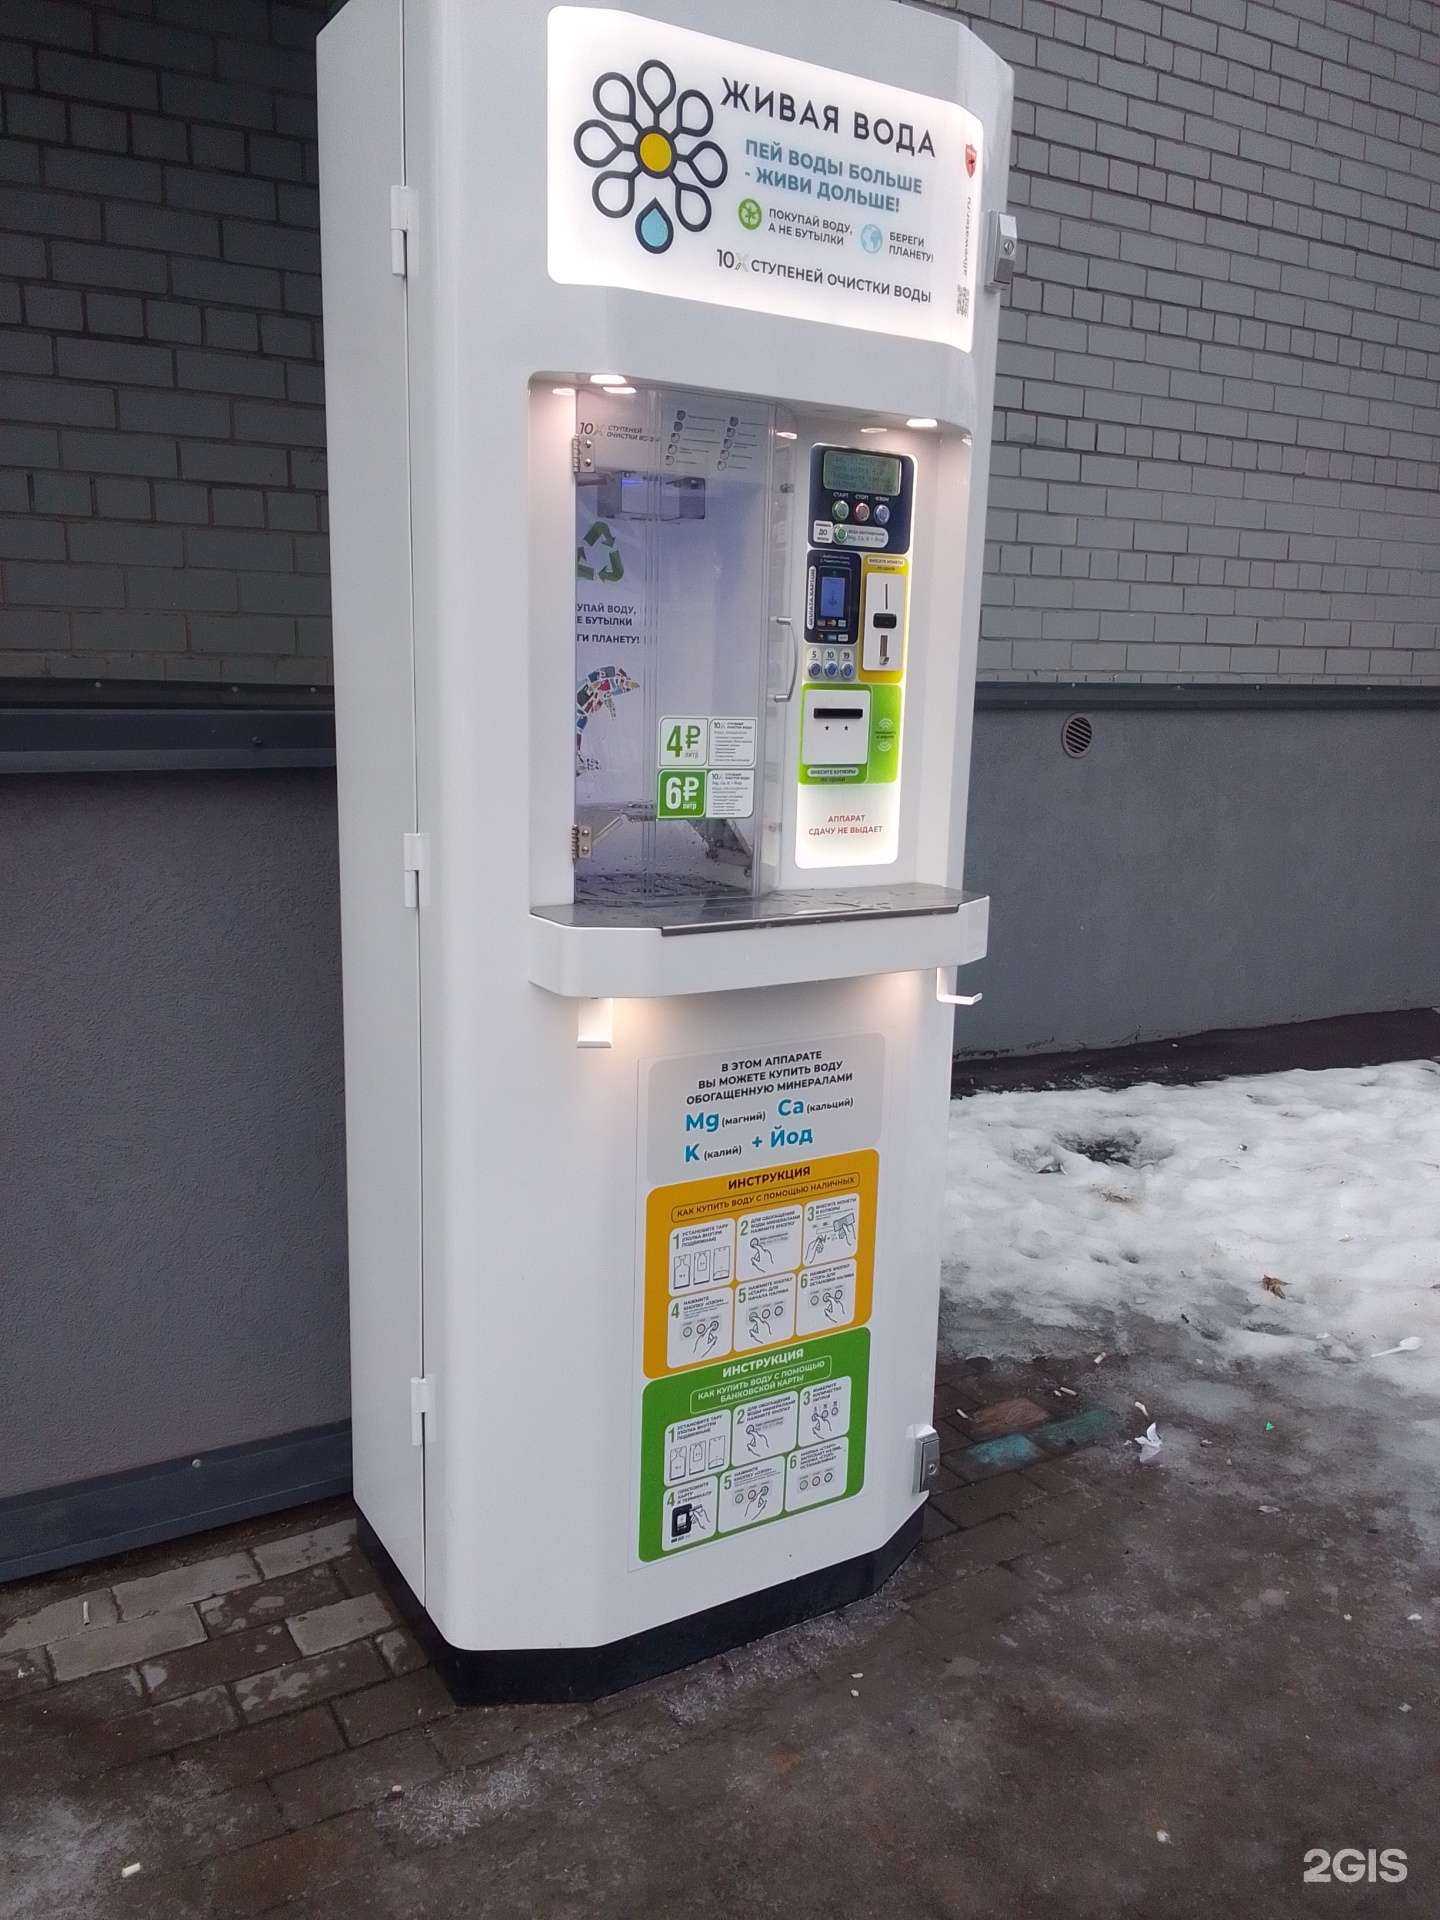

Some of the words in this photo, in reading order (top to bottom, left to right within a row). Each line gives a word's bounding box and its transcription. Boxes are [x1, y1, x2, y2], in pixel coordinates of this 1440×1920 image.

[720, 76, 839, 134] ЖИВАЯ
[853, 111, 935, 158] ВОДА
[745, 139, 782, 162] ПЕЙ
[788, 149, 843, 177] ВОДЫ
[849, 163, 922, 194] БОЛЬШЕ
[756, 167, 812, 194] ЖИВИ
[817, 181, 900, 213] ДОЛЬШЕ!
[769, 208, 820, 228] ПОКУПАЙ
[822, 219, 853, 235] ВОДУ,
[768, 223, 776, 233] А
[779, 225, 793, 236] НЕ
[795, 227, 844, 246] БУТЫЛКИ
[889, 232, 925, 247] БЕРЕГИ
[889, 245, 934, 263] ПЛАНЕТУ!
[751, 259, 823, 284] СТУПЕНЕЙ
[827, 273, 890, 295] ОЧИСТКИ
[894, 286, 931, 303] ВОДЫ
[607, 604, 637, 615] ВОДУ,
[585, 616, 632, 626] БУТЫЛКИ
[592, 634, 640, 644] ПЛАНЕТУ!
[827, 651, 834, 659] 10
[828, 814, 865, 823] АППАРАТ
[808, 826, 835, 836] СДАЧУ
[837, 826, 848, 834] НЕ
[850, 825, 882, 834] ВЫДАЕТ
[721, 1063, 729, 1072] В
[732, 1059, 762, 1071] ЭТОМ
[765, 1050, 822, 1066] АППАРАТЕ
[698, 1079, 716, 1089] ВЫ
[719, 1072, 766, 1087] МОЖЕТЕ
[769, 1066, 811, 1079] КУПИТЬ
[814, 1061, 843, 1073] ВОДУ
[686, 1084, 774, 1105] ОБОГАЩЕННУЮ
[777, 1072, 853, 1091] МИНЕРАЛАМИ
[685, 1112, 719, 1132] Mg
[722, 1111, 766, 1128] (магний)
[778, 1098, 804, 1116] Ca
[806, 1097, 854, 1114] (кальций)
[703, 1145, 742, 1161] (калий)
[752, 1136, 763, 1148] +
[770, 1125, 813, 1148] Йод
[728, 1166, 810, 1191] ИНСТРУКЦИЯ
[677, 1207, 695, 1217] КАК
[696, 1202, 730, 1213] КУПИТЬ
[732, 1195, 754, 1208] ВОДУ
[763, 1185, 809, 1200] ПОМОЩЬЮ
[810, 1176, 855, 1191] НАЛИЧНЫХ
[807, 1206, 815, 1222] 3
[740, 1220, 749, 1236] 2
[673, 1233, 680, 1249] 1
[800, 1274, 808, 1288] 6
[738, 1287, 746, 1303] 5
[671, 1302, 680, 1318] 4
[722, 1348, 804, 1378] ИНСТРУКЦИЯ
[698, 1389, 715, 1400] КАК
[717, 1381, 749, 1395] КУПИТЬ
[750, 1375, 772, 1387] ВОДУ
[781, 1360, 825, 1377] ПОМОЩЬЮ
[720, 1381, 776, 1402] БАНКОВСКОЙ
[777, 1375, 804, 1388] КАРТЫ
[803, 1391, 811, 1406] 3
[736, 1409, 745, 1425] 2
[668, 1427, 675, 1443] 1
[790, 1455, 797, 1469] 6
[724, 1475, 732, 1490] 5
[667, 1492, 675, 1506] 4
